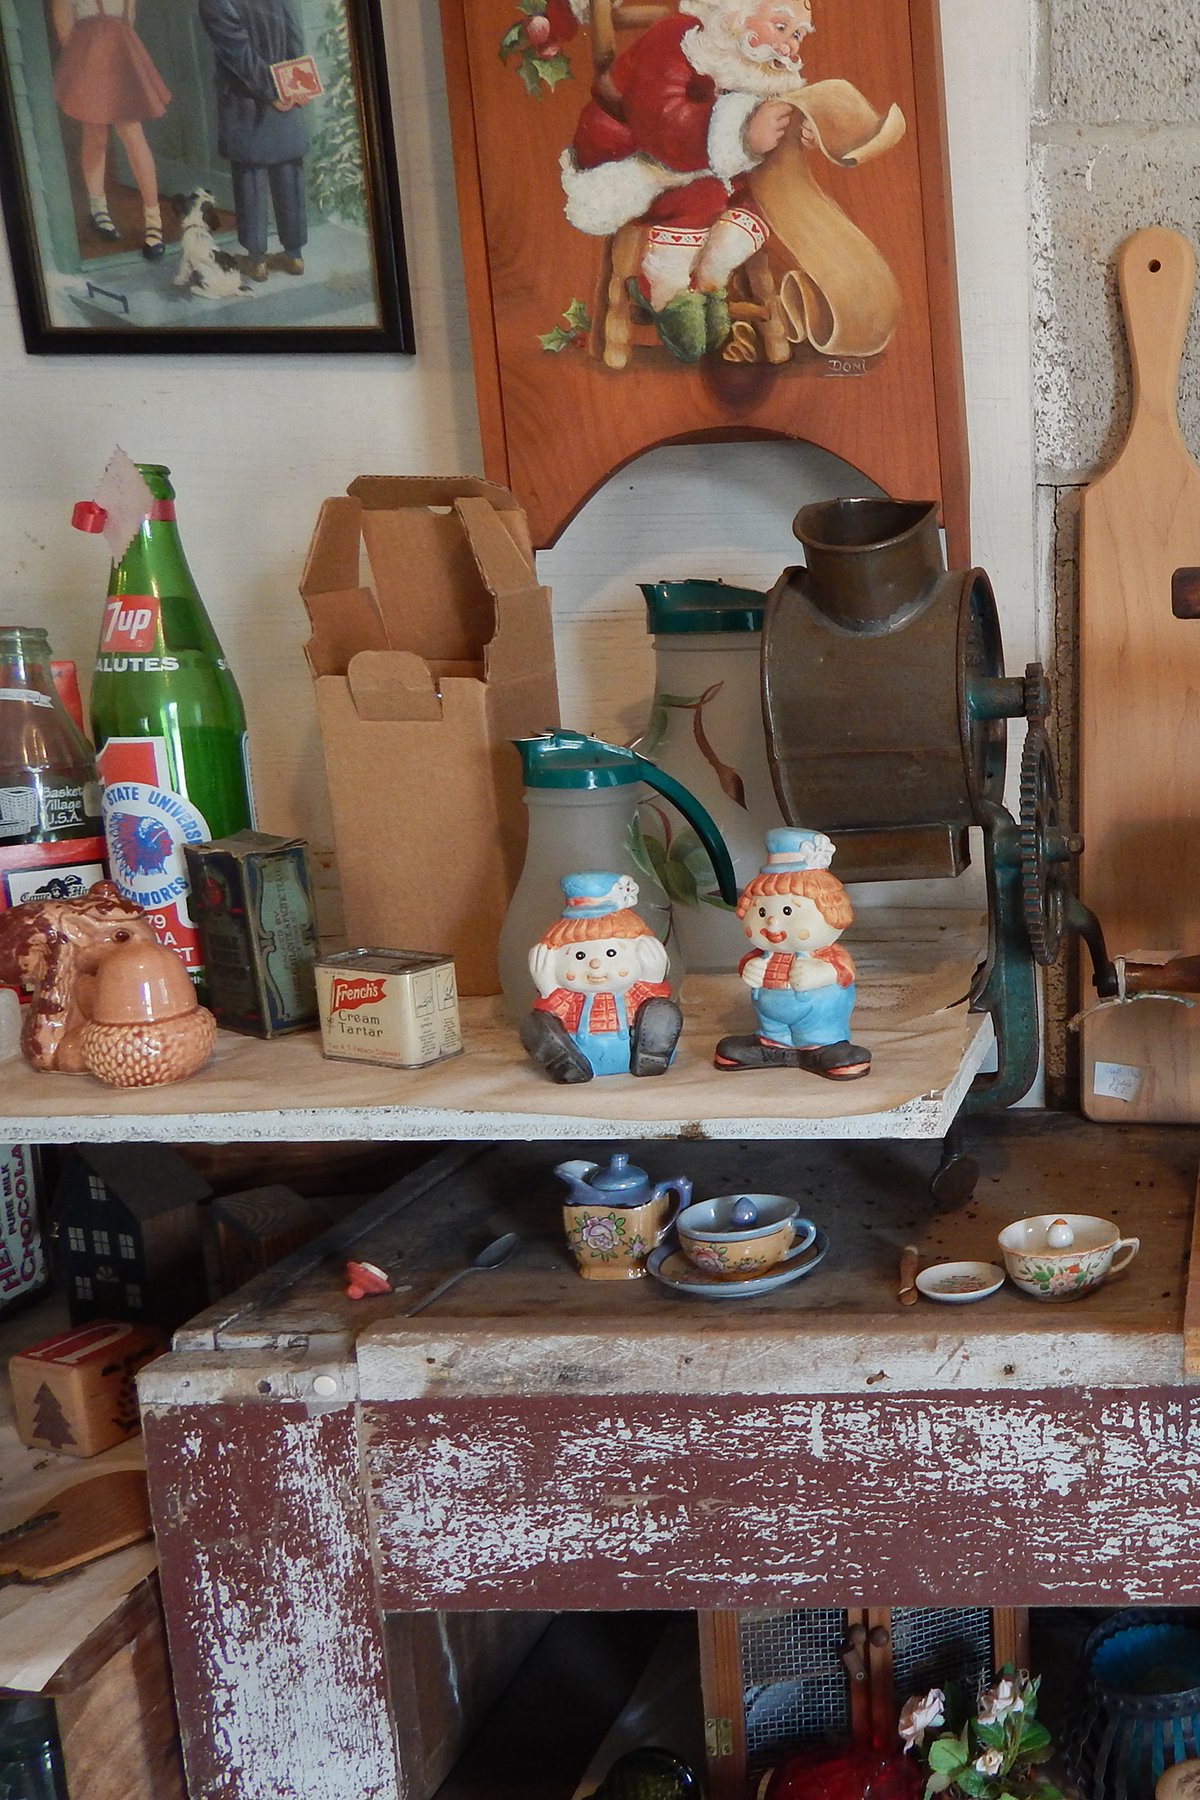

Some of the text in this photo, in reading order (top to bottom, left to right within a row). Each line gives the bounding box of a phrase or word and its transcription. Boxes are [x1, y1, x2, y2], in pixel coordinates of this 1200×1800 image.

[104, 601, 152, 642] 7up
[43, 786, 83, 798] Basket
[106, 786, 139, 806] STATE
[45, 799, 82, 812] Village
[335, 983, 379, 1008] French's
[338, 1010, 380, 1024] Cream
[338, 1022, 383, 1037] Tartar
[1, 1163, 17, 1235] PURE MILK
